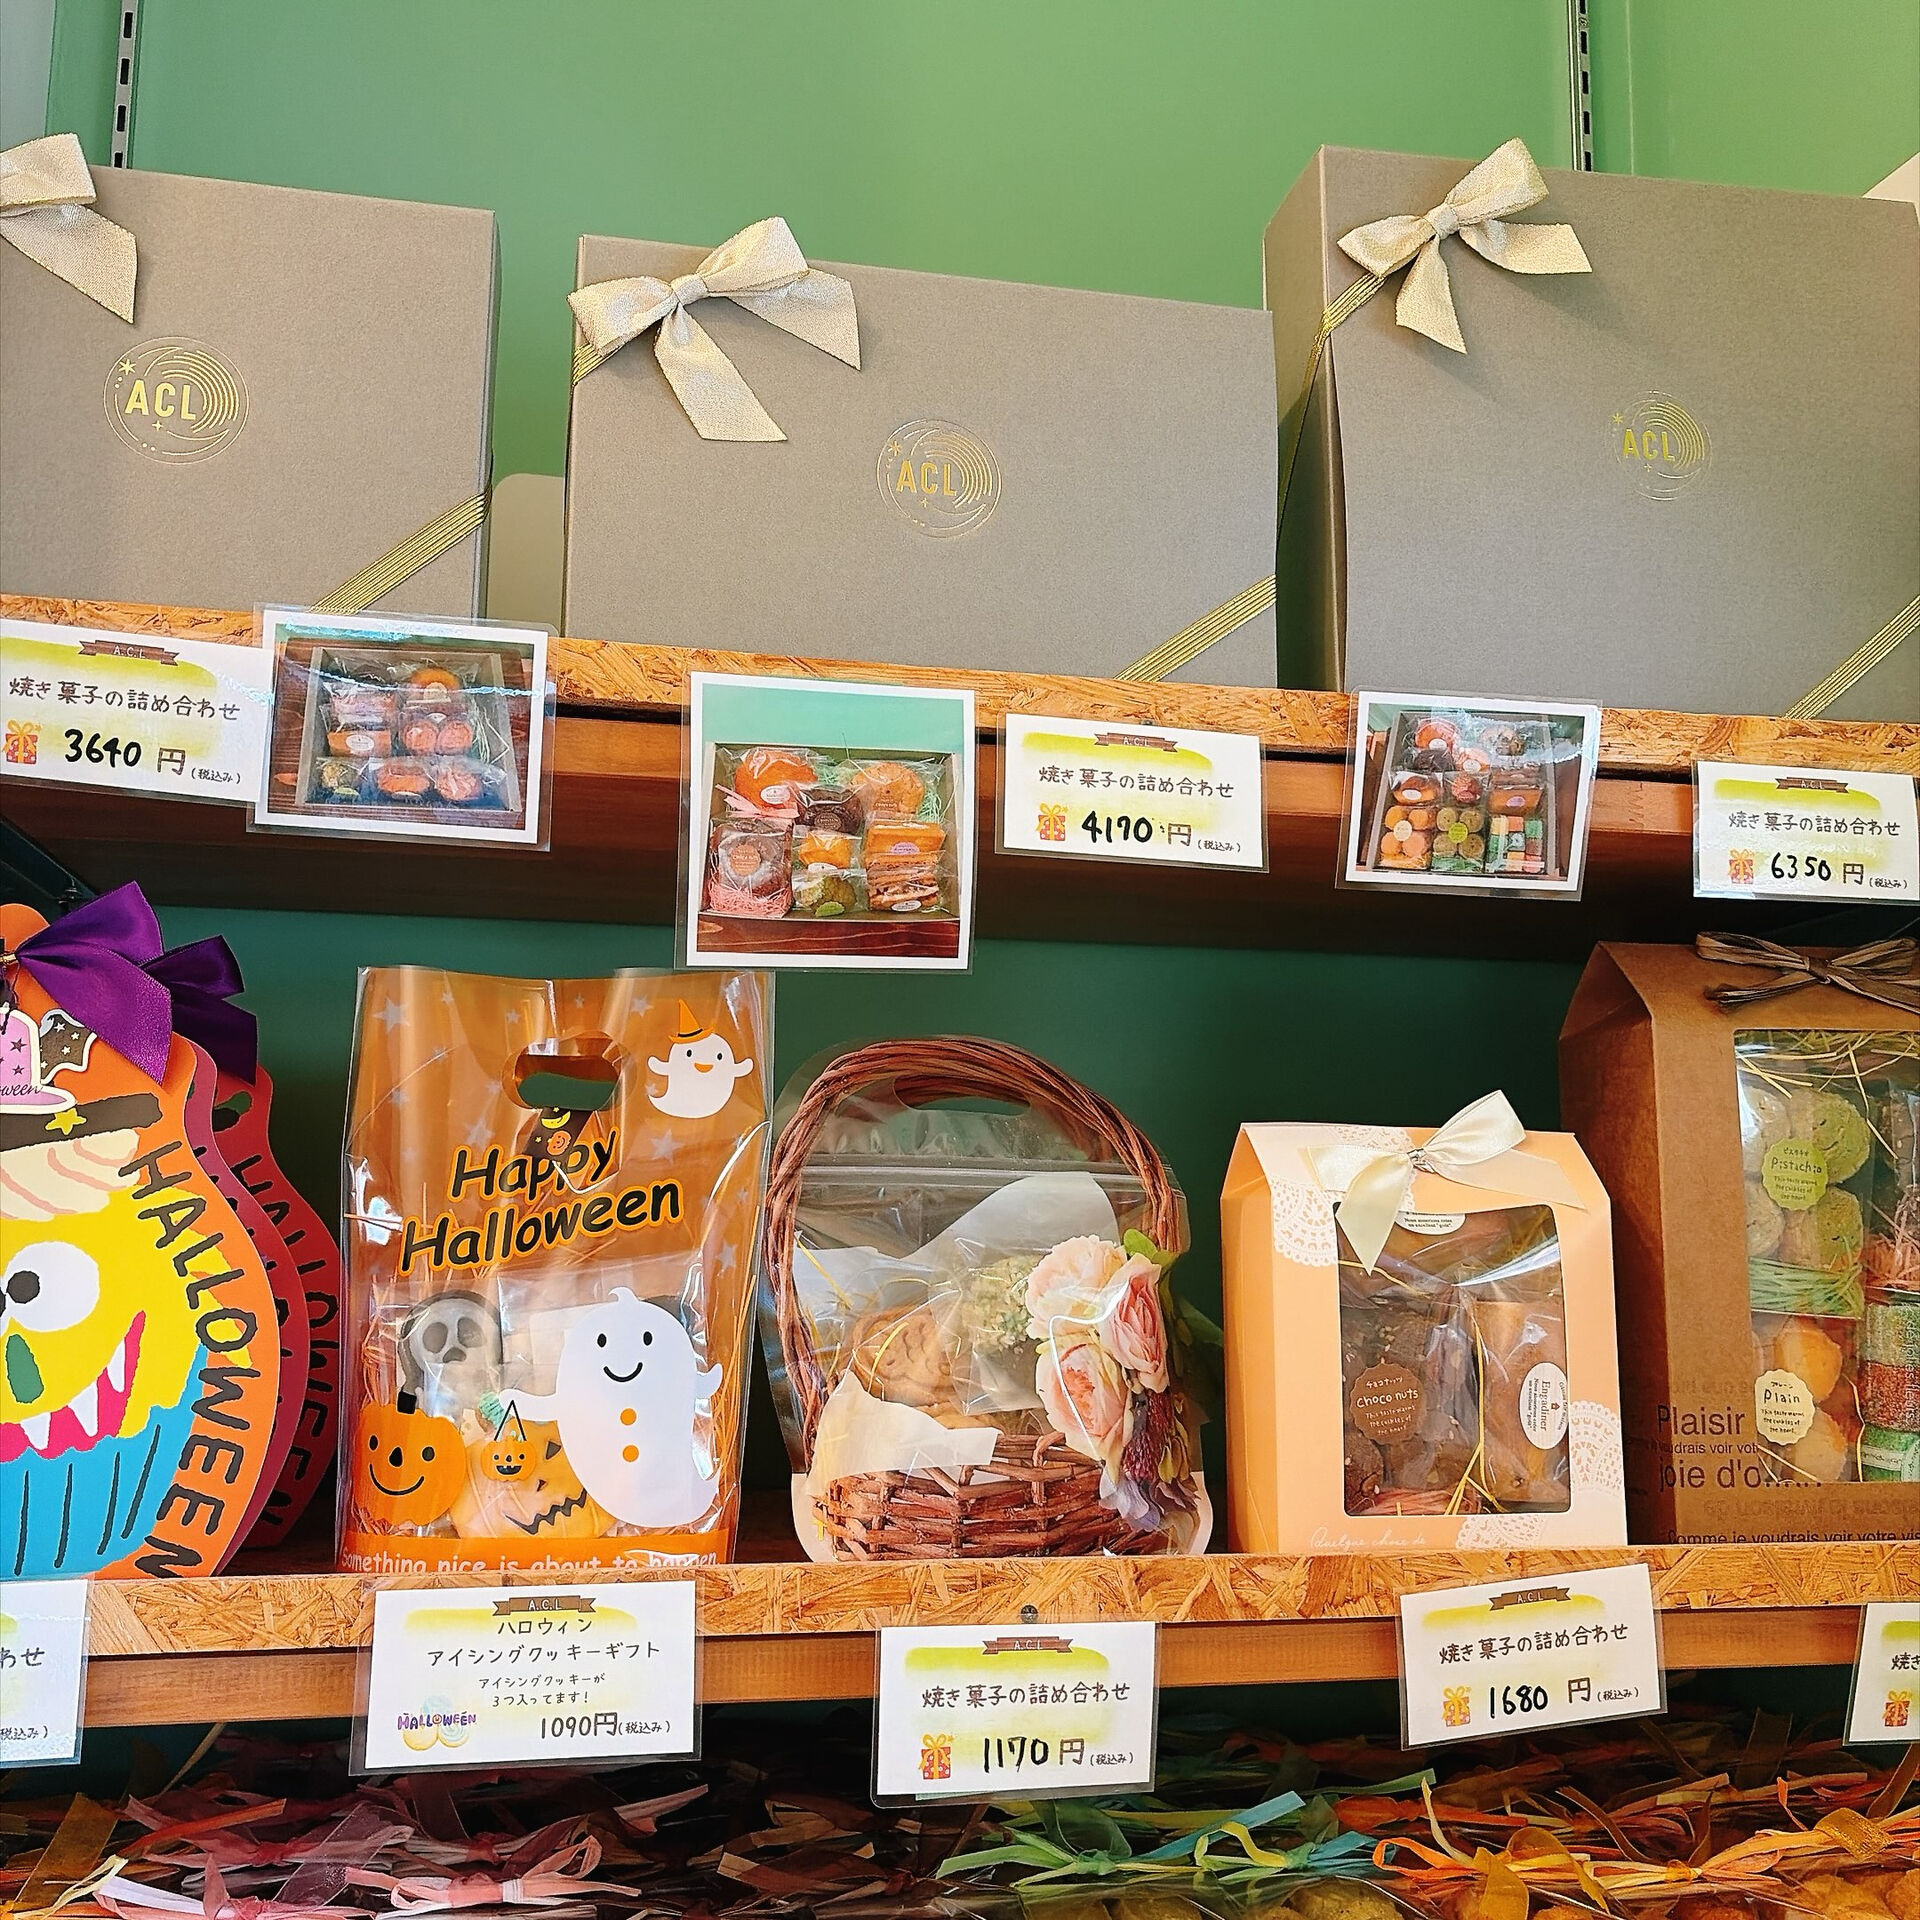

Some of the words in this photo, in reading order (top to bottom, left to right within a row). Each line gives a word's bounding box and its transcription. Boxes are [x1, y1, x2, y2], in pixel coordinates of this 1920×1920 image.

[124, 379, 197, 421] ACL
[1622, 428, 1676, 462] ACL
[895, 460, 958, 497] ACL
[9, 675, 241, 721] 焼き菓子の詰め合わせ
[64, 728, 142, 767] 3640
[157, 747, 186, 776] 円
[1038, 765, 1235, 798] 焼き菓子の詰め合わせ
[1081, 810, 1153, 843] 4170
[1167, 822, 1192, 846] 円
[1728, 810, 1901, 836] 焼き菓子の詰め合わせ
[1771, 852, 1832, 881] 6350
[1843, 863, 1864, 885] 円
[449, 1127, 620, 1200] Happy
[1771, 1157, 1822, 1173] Pistachio
[401, 1181, 681, 1271] Halloween
[118, 1141, 258, 1577] HALLOWEEN
[1395, 1388, 1419, 1401] nuts
[1539, 1381, 1551, 1432] Engadiner
[1764, 1388, 1800, 1404] Plain
[1657, 1404, 1745, 1435] Plaisir
[1709, 1442, 1733, 1454] voir
[1658, 1457, 1705, 1492] joie
[1751, 1530, 1819, 1543] voudrais
[438, 1555, 487, 1573] nice
[500, 1555, 519, 1572] is
[497, 1617, 593, 1635] ハロウィン
[427, 1641, 660, 1667] アイシングクッキーギフト
[1439, 1623, 1629, 1665] 焼き菓子の詰め合わせ
[478, 1672, 606, 1690] アイシングクッキーが
[922, 1680, 1131, 1709] 焼き菓子の詰め合わせ
[1490, 1684, 1548, 1719] 1680
[1567, 1676, 1592, 1704] 円
[397, 1711, 477, 1730] HALLOWEEN
[983, 1735, 1049, 1773] 1170
[1059, 1737, 1085, 1766] 円
